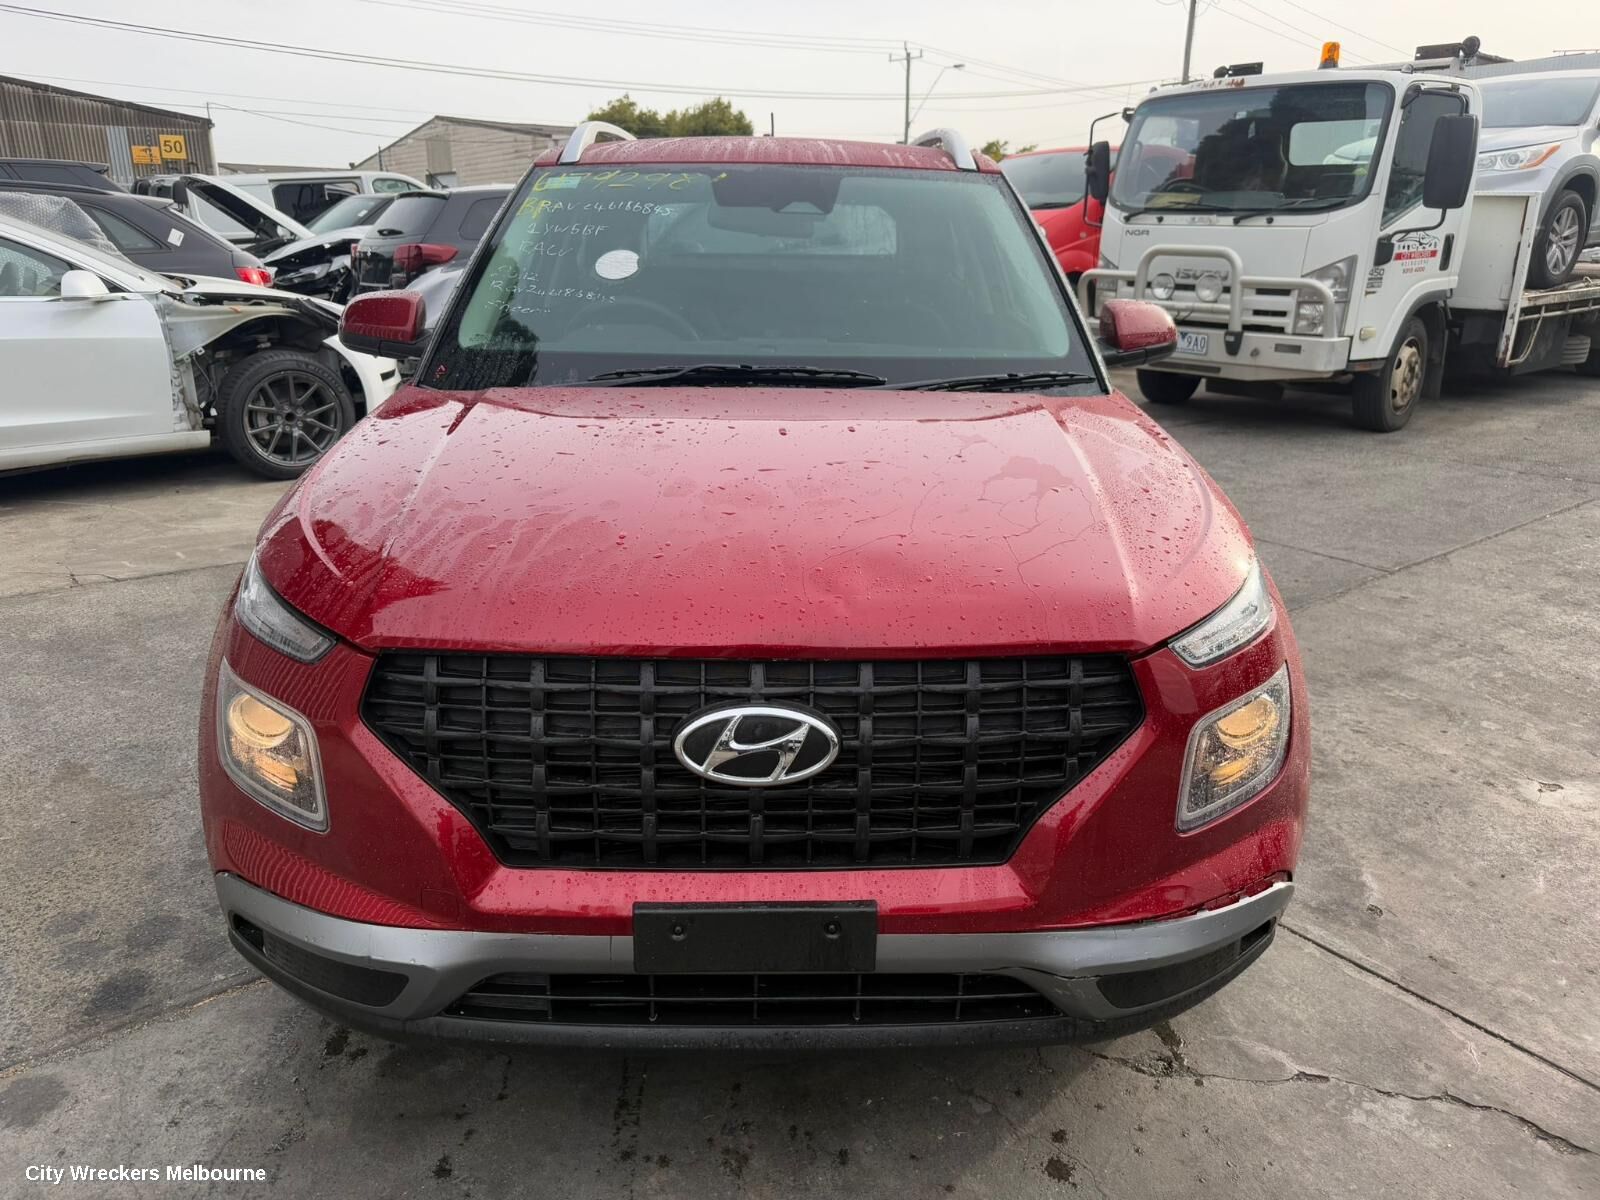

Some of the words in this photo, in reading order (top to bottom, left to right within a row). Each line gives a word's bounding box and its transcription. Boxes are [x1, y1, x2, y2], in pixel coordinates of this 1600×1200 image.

[163, 140, 183, 154] 50
[1175, 268, 1229, 281] ISUU
[1368, 268, 1385, 276] 450
